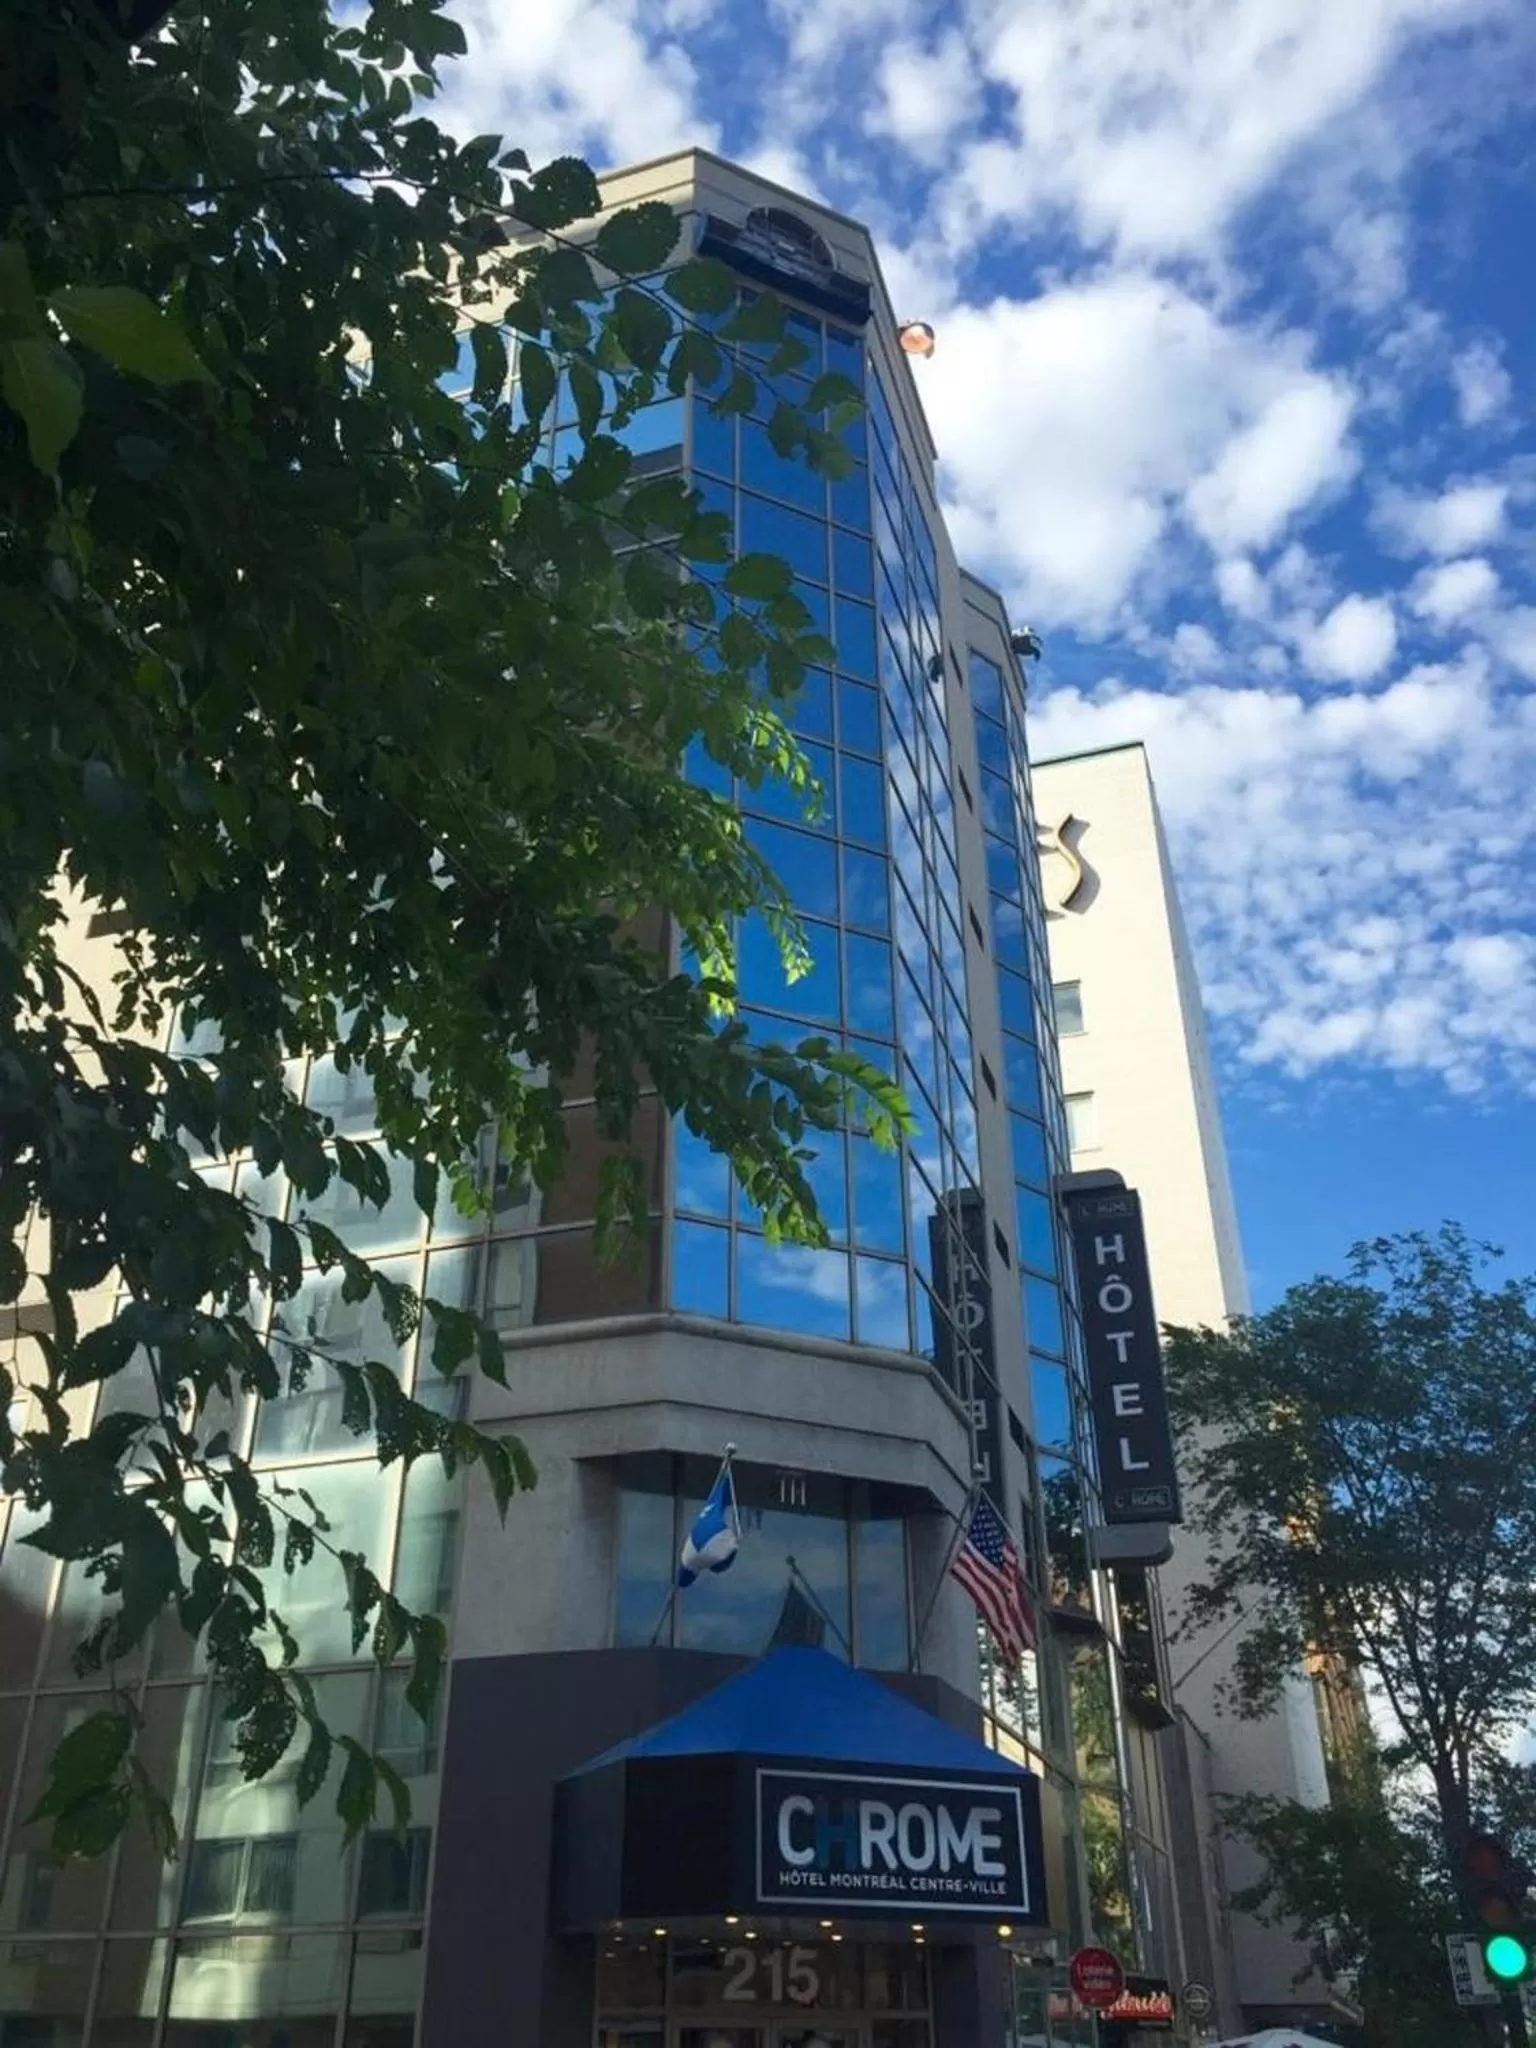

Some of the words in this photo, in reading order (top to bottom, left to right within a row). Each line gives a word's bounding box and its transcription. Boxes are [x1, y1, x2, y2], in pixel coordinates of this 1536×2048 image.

[1094, 1233, 1150, 1472] HÔTEL
[778, 1795, 1007, 1876] CHROME
[779, 1868, 826, 1887] HÔTEL
[829, 1872, 907, 1890] MONTRÉAL
[909, 1877, 1008, 1895] CENTRE-VILLE
[722, 1946, 820, 2002] 215
